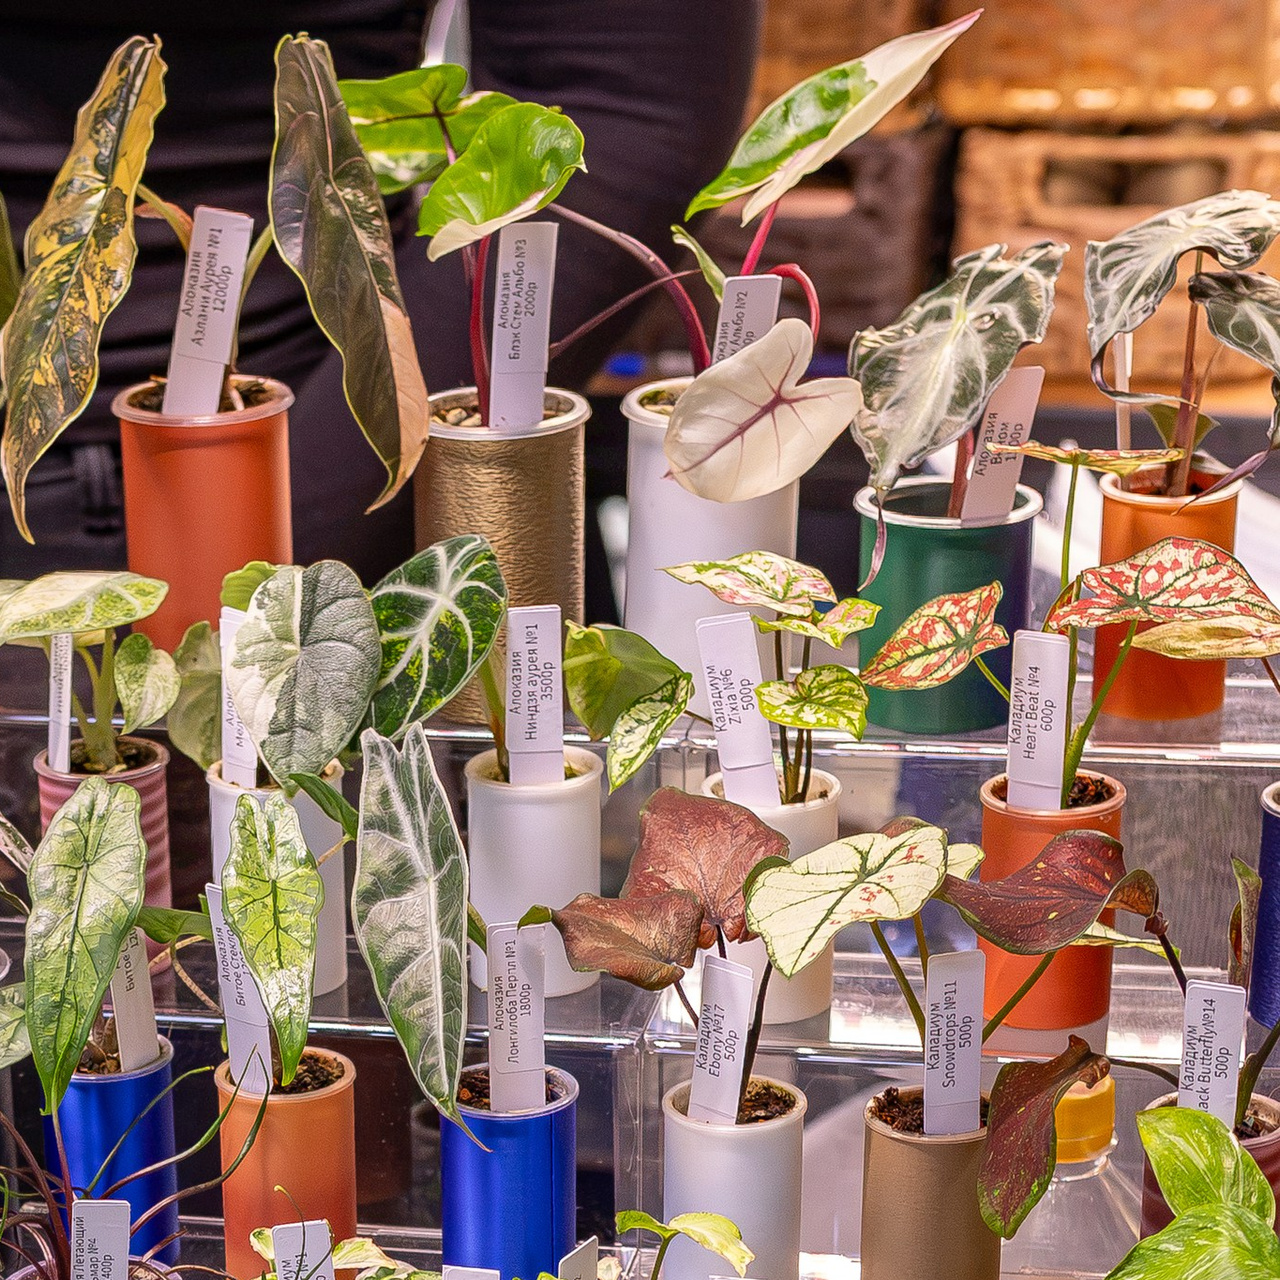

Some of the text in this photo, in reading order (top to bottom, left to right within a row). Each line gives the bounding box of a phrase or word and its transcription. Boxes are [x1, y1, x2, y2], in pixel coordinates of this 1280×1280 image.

[181, 250, 202, 317] Алоказия
[191, 227, 222, 347] Азлани Аурея №1
[212, 264, 233, 313] 12000р
[498, 271, 511, 328] Алоказия
[508, 239, 526, 359] Блэк Стем Альбо №3
[525, 281, 537, 316] 2000р
[731, 290, 747, 346] Альбо №2
[508, 651, 522, 714] Алоказия
[524, 623, 540, 740] Ниндзя аурея №1
[540, 661, 556, 700] 3500р
[707, 664, 727, 732] Каладиум
[719, 668, 741, 725] Zixia №6
[738, 677, 755, 711] 500р
[1009, 676, 1026, 744] Каладиум
[1023, 665, 1040, 759] Heart Beat №4
[1040, 699, 1056, 731] 600р
[123, 954, 135, 991] Битое
[216, 926, 231, 982] Алоказия
[227, 928, 240, 969] Стекло
[234, 970, 246, 1006] Битое
[493, 975, 504, 1030] Алоказия
[505, 939, 519, 1063] Лонгилоба Перпл №1
[520, 983, 532, 1016] 1800р
[695, 1003, 713, 1070] Каладиум
[708, 1003, 725, 1077] Ebony №17
[723, 1029, 739, 1062] 500р
[927, 1002, 943, 1070] Каладиум
[942, 980, 958, 1087] Snowdrops №11
[959, 1015, 974, 1047] 500р
[1180, 1024, 1200, 1091] Каладиум
[1214, 1046, 1232, 1079] 500р
[72, 1216, 86, 1271] Летающий
[87, 1237, 98, 1254] №4
